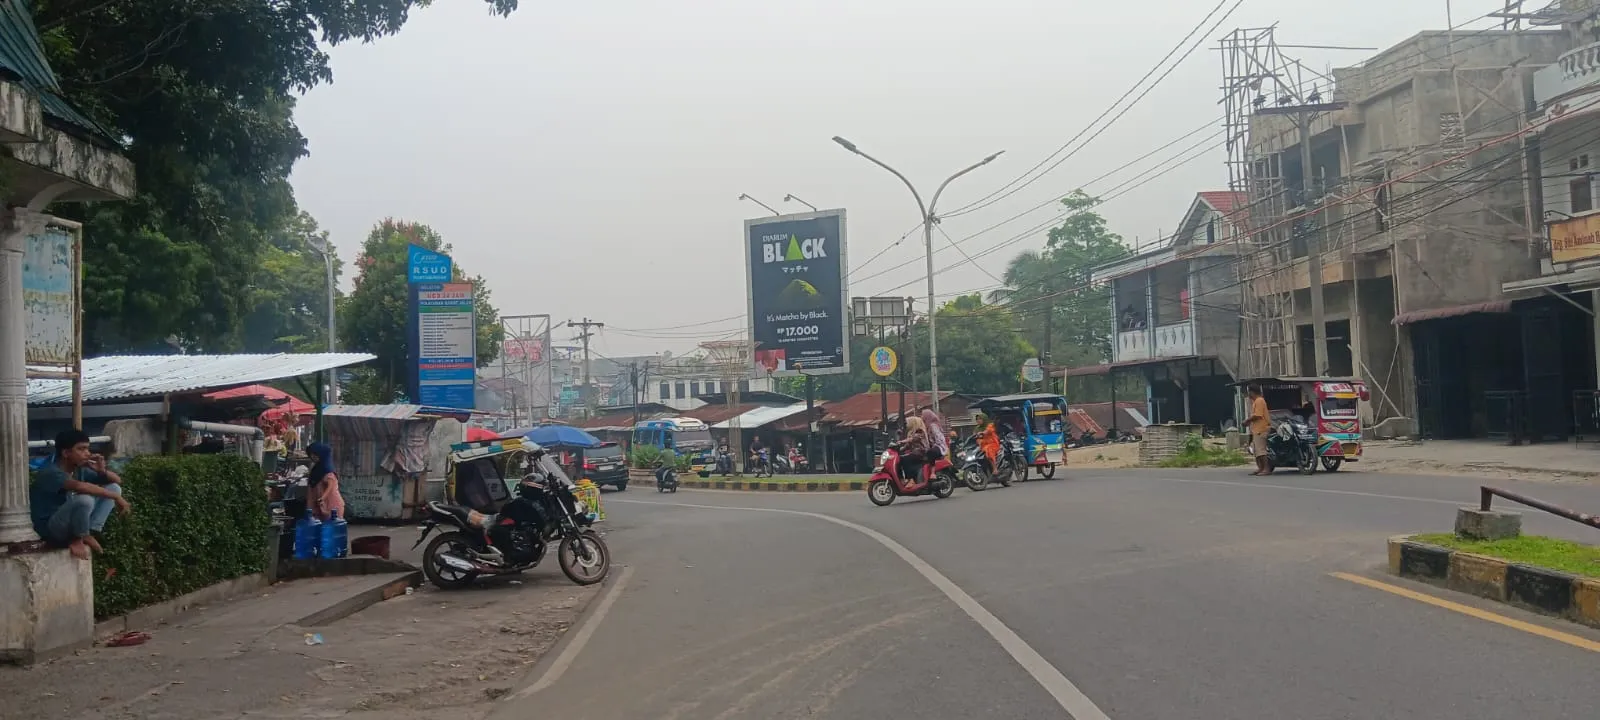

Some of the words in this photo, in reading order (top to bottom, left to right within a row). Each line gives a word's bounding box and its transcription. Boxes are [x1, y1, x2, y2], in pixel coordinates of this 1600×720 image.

[762, 233, 788, 242] DJARUM
[763, 237, 827, 263] BLACK
[413, 266, 447, 274] RSUD
[775, 312, 800, 321] Matcha
[800, 311, 808, 320] by
[809, 308, 829, 319] Black.
[785, 325, 819, 337] 17.000
